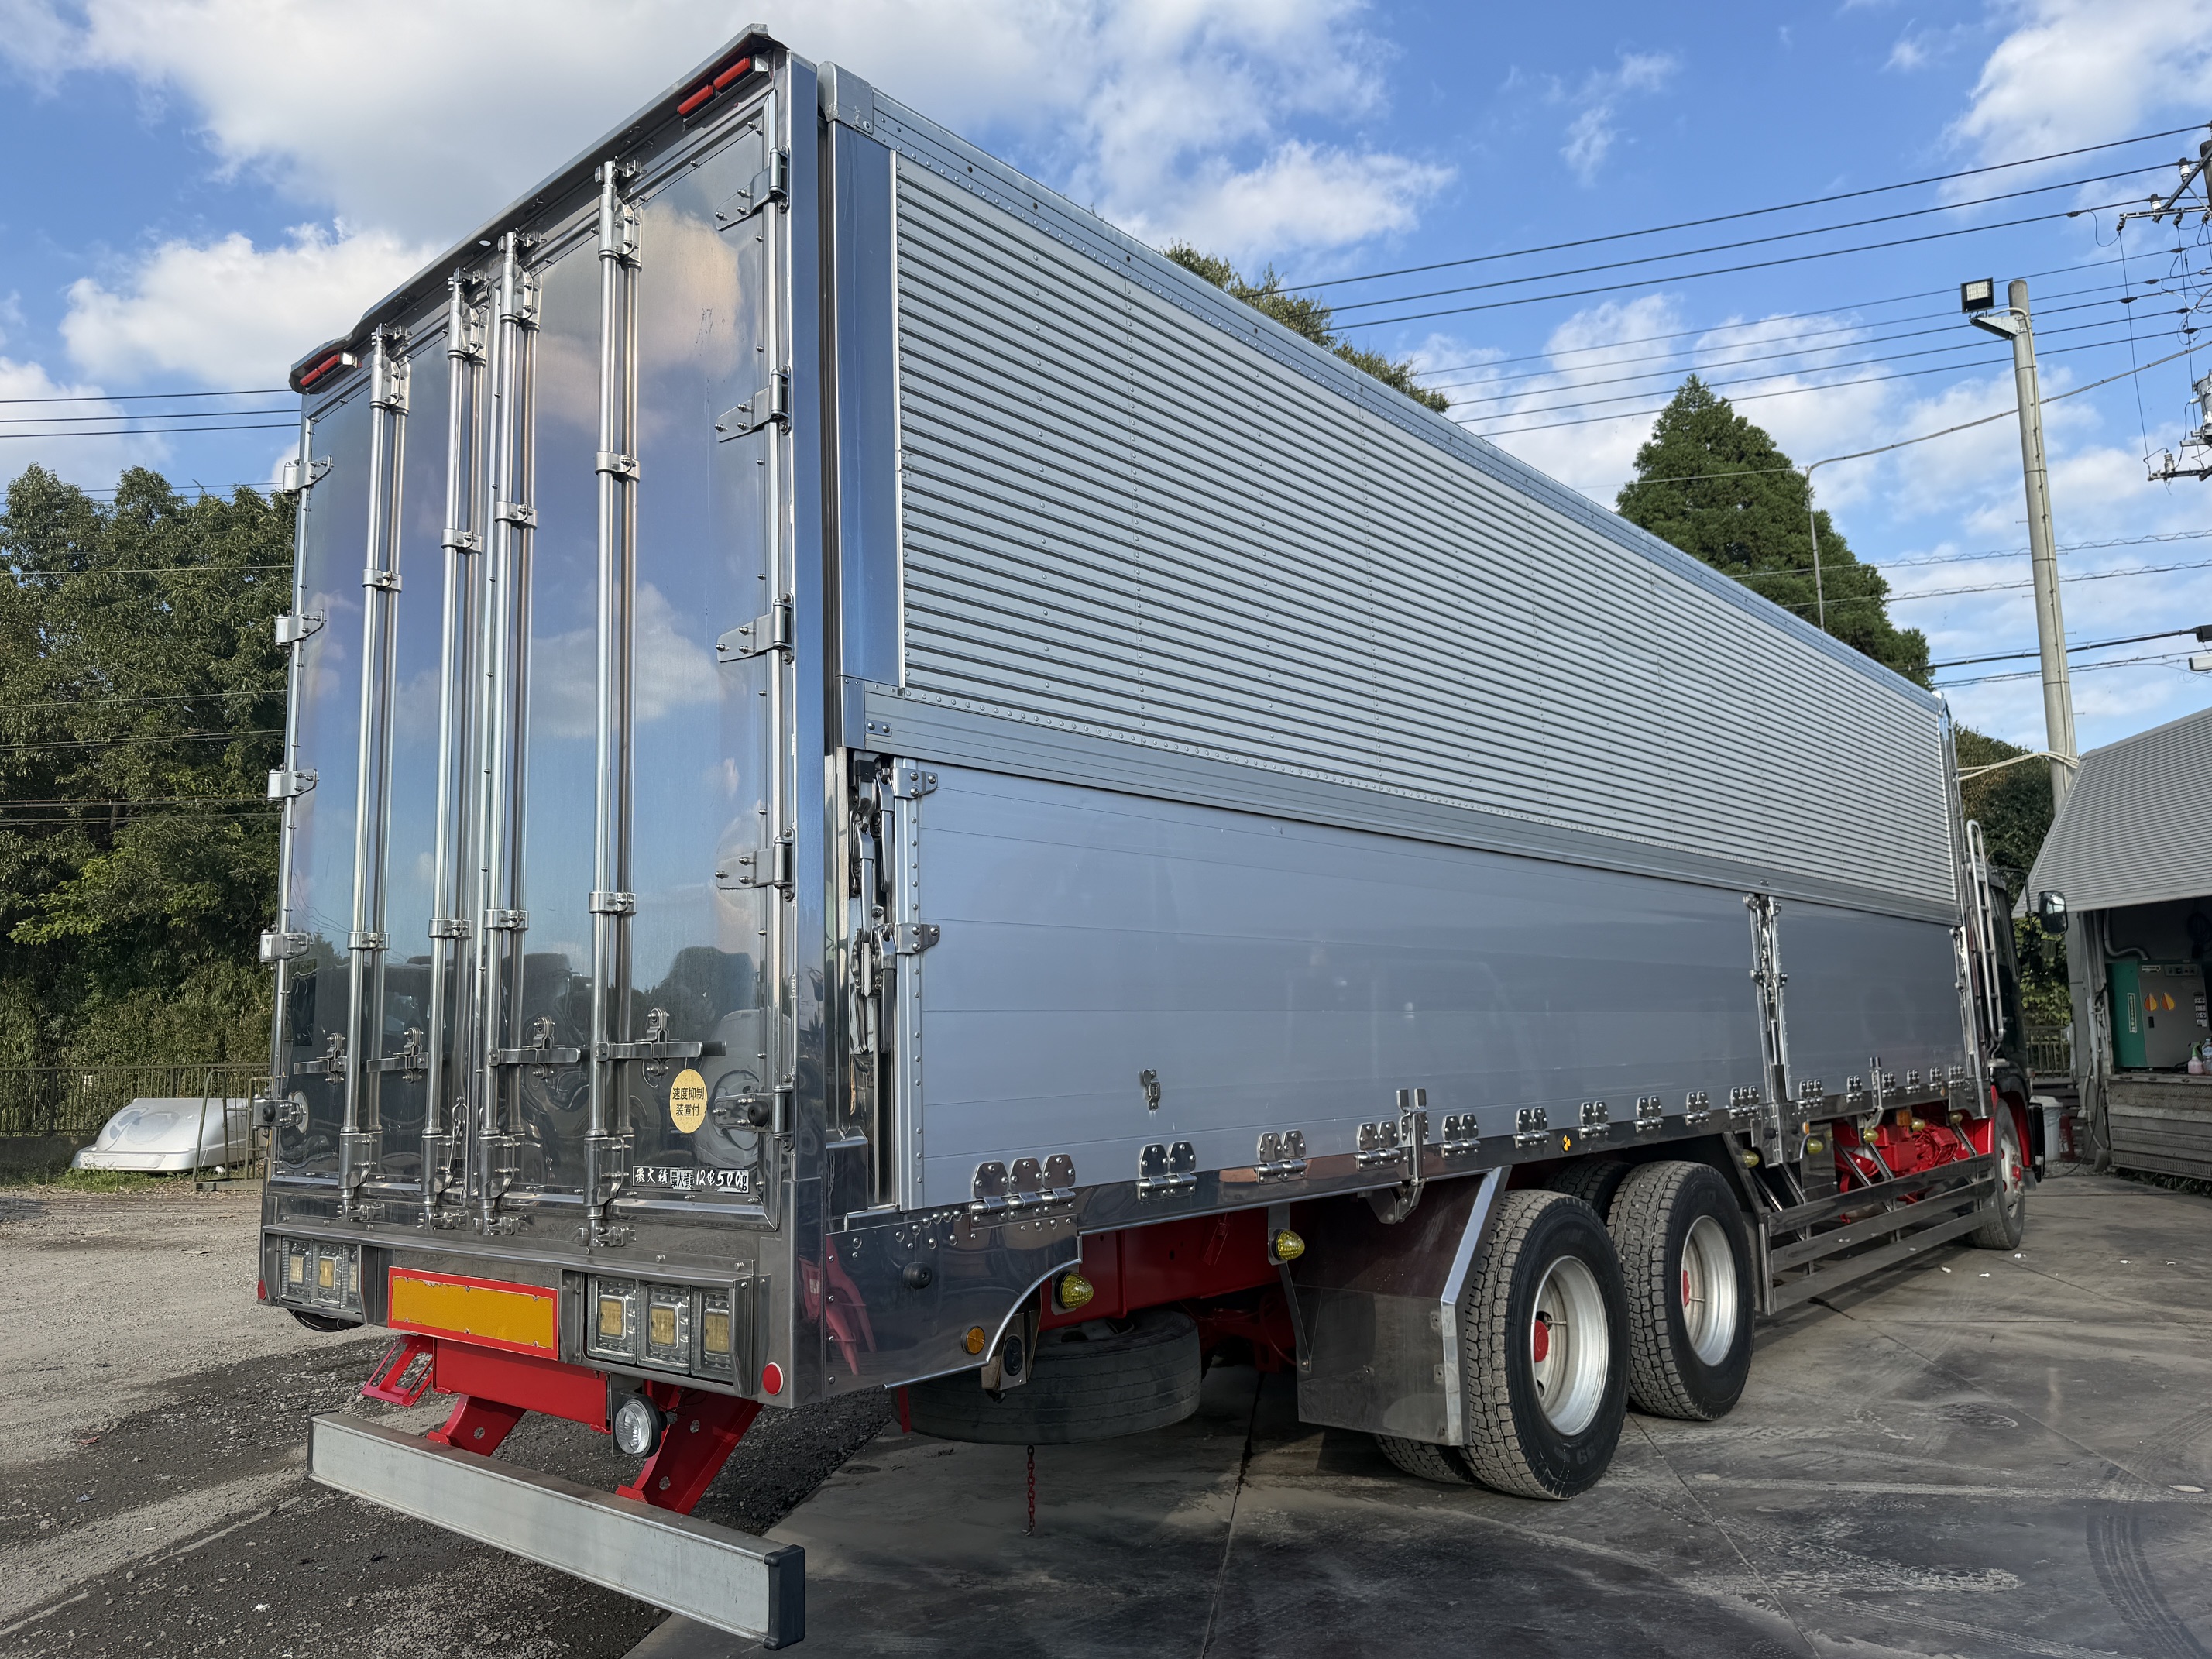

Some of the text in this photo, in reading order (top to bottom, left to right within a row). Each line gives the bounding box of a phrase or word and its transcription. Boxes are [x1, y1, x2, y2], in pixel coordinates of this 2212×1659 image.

[672, 1087, 704, 1100] 速度抑制
[675, 1103, 700, 1116] 装置付
